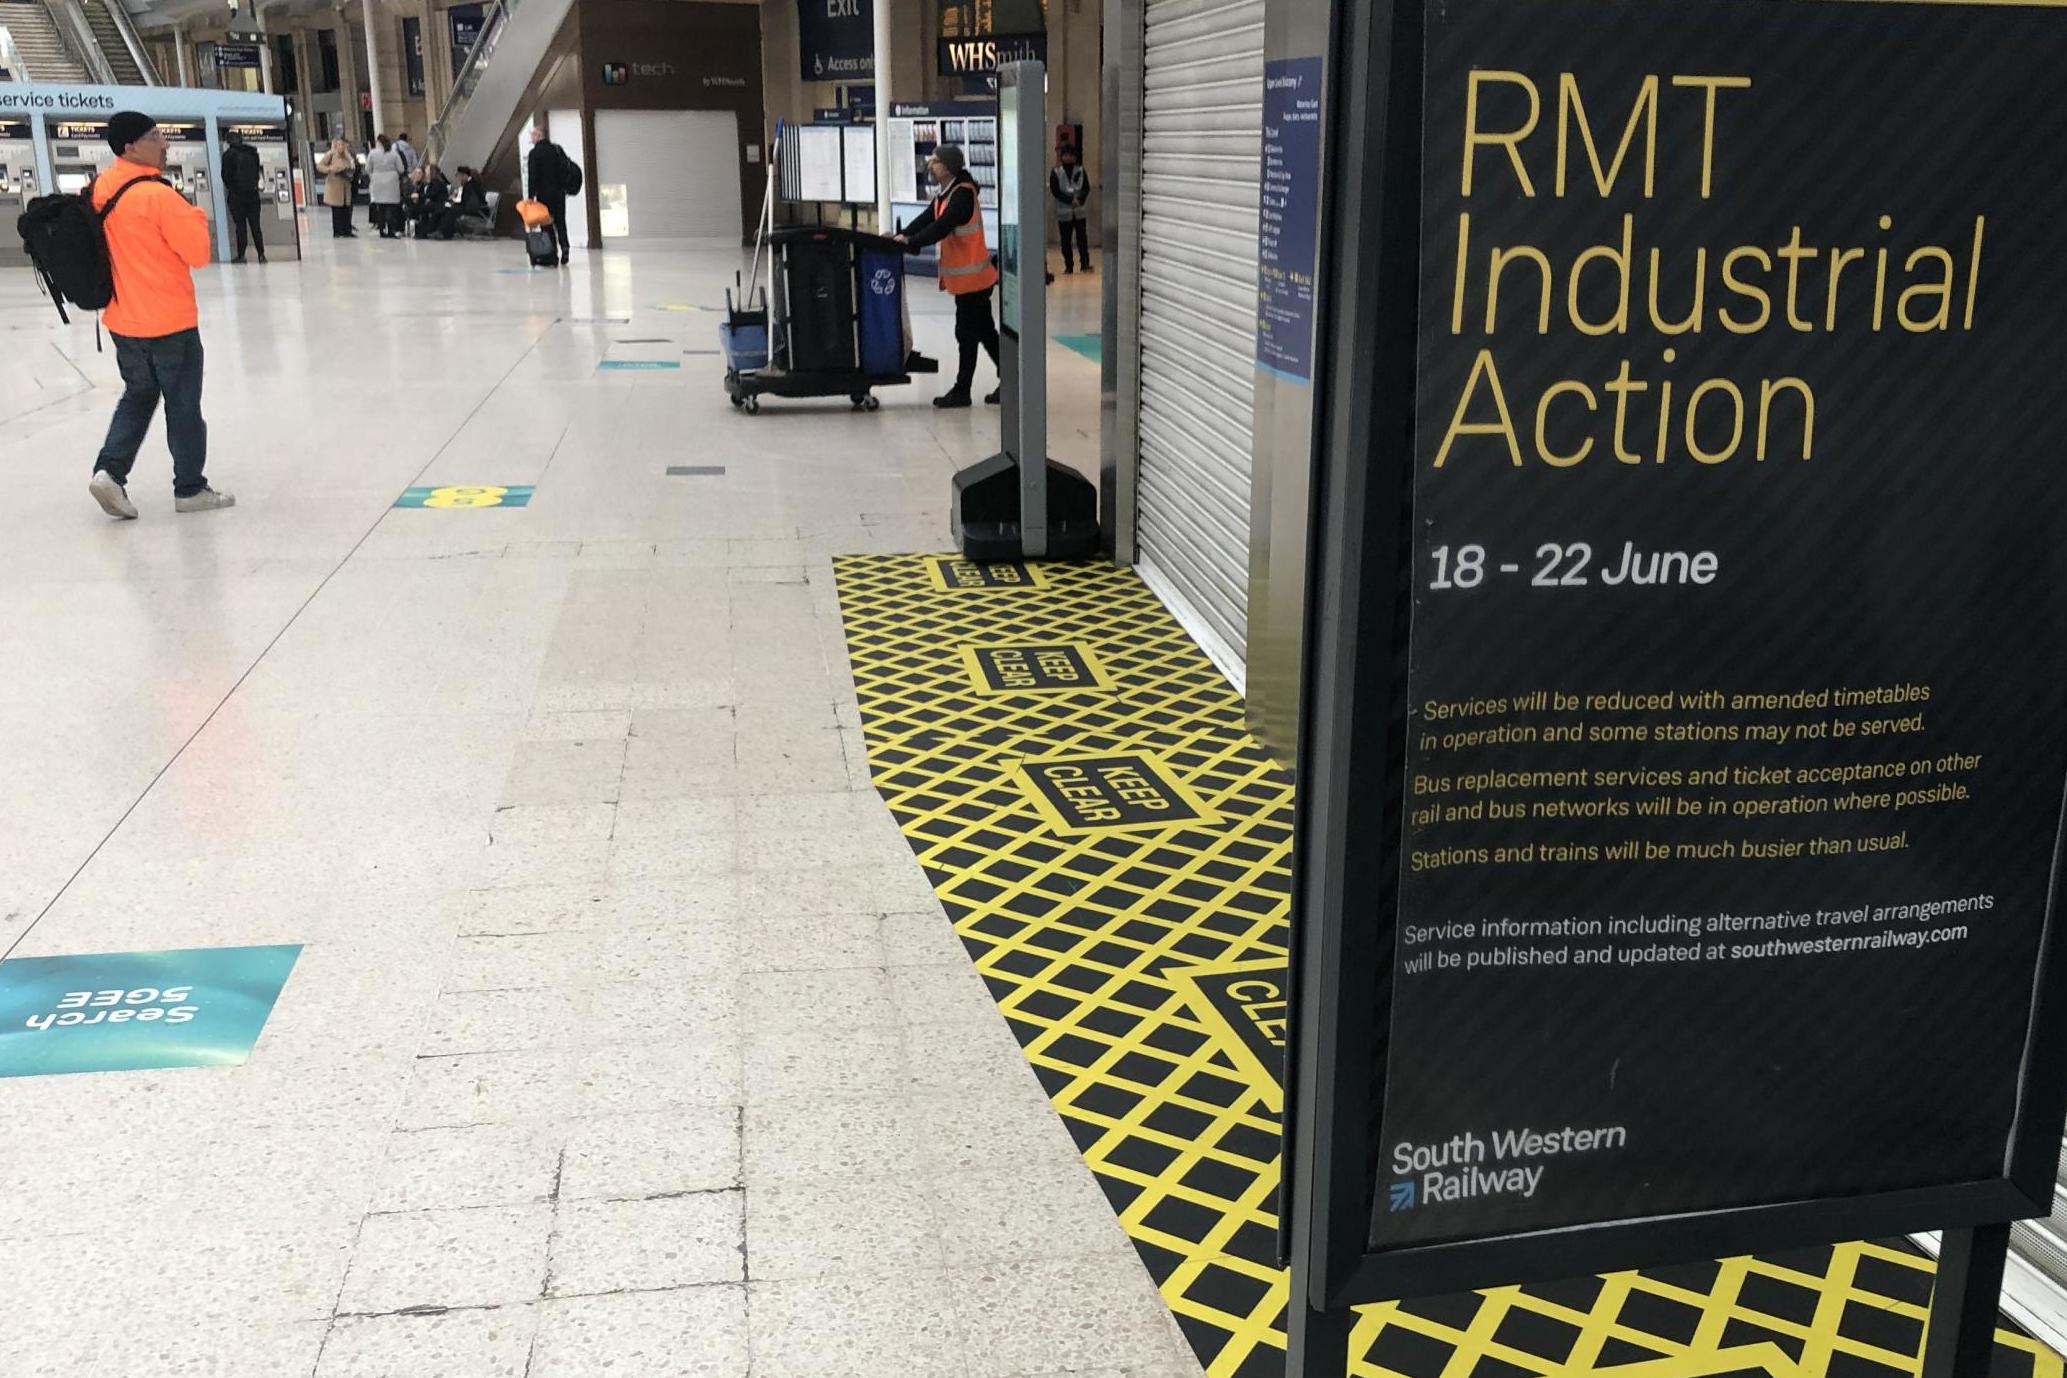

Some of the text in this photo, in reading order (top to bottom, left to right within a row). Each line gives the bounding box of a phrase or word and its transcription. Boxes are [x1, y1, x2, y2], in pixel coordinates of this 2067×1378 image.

[632, 62, 675, 76] tech
[828, 53, 875, 71] Access onl
[948, 40, 1036, 71] WHSmith
[0, 91, 114, 108] ervice tickets
[1461, 69, 1752, 199] RMT
[1451, 212, 1985, 336] Industrial
[1433, 347, 1816, 468] Action
[1430, 544, 1486, 589] 18
[1531, 542, 1592, 587] 22
[1601, 541, 1719, 585] June
[990, 650, 1036, 687] CLEAR
[1034, 651, 1079, 681] KEEP
[1424, 683, 1930, 720] Services will be reduced with amended timetables
[1420, 712, 1925, 751] in operation and some stations may not be served.
[1044, 766, 1121, 822] CLEAR
[1097, 766, 1170, 810] KEEP
[1414, 753, 1982, 795] Bus replacement services and ticket acceptance on other
[1411, 782, 1970, 826] rail and bus networks will be in operation where possible.
[1411, 831, 1909, 872] Stations and trains will be much busier than usual.
[1405, 894, 1994, 944] Service information including alternative travel arrangements
[1405, 924, 1968, 974] will be published and updated at southwesternrailway.com
[57, 986, 193, 1008] 5GEE
[1226, 980, 1288, 1046] CLE
[26, 1006, 199, 1030] Search
[1392, 1126, 1626, 1175] South Western
[1422, 1165, 1544, 1205] Railway
